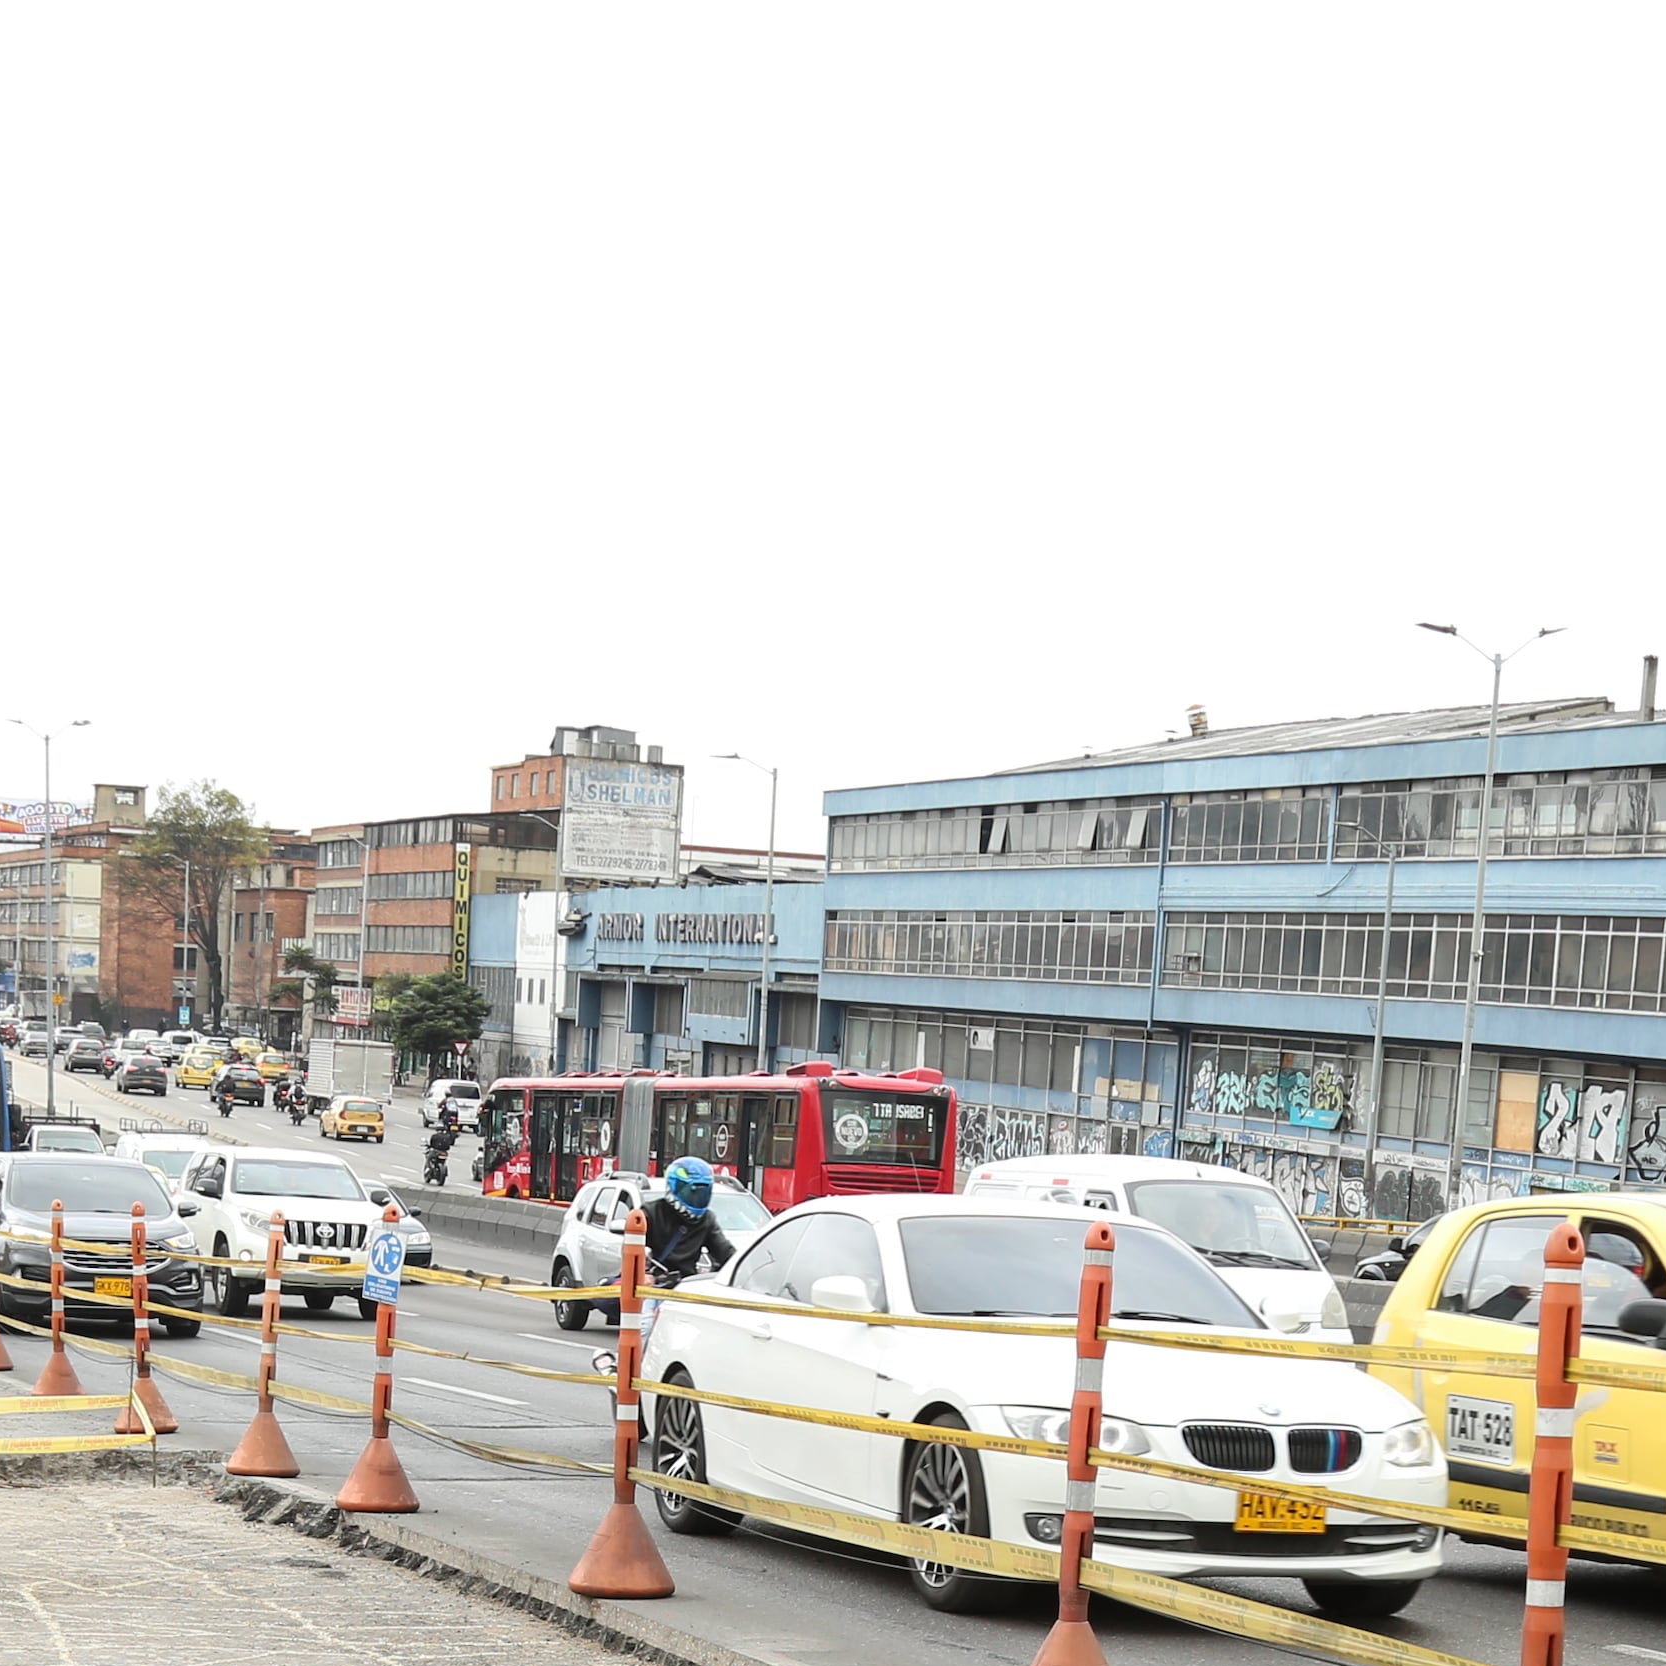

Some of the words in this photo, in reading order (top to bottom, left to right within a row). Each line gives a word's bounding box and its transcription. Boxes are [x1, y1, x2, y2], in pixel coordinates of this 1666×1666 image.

[587, 784, 671, 806] SHELMAN
[454, 852, 469, 980] QUIMICOS
[597, 913, 645, 942] ARMOR
